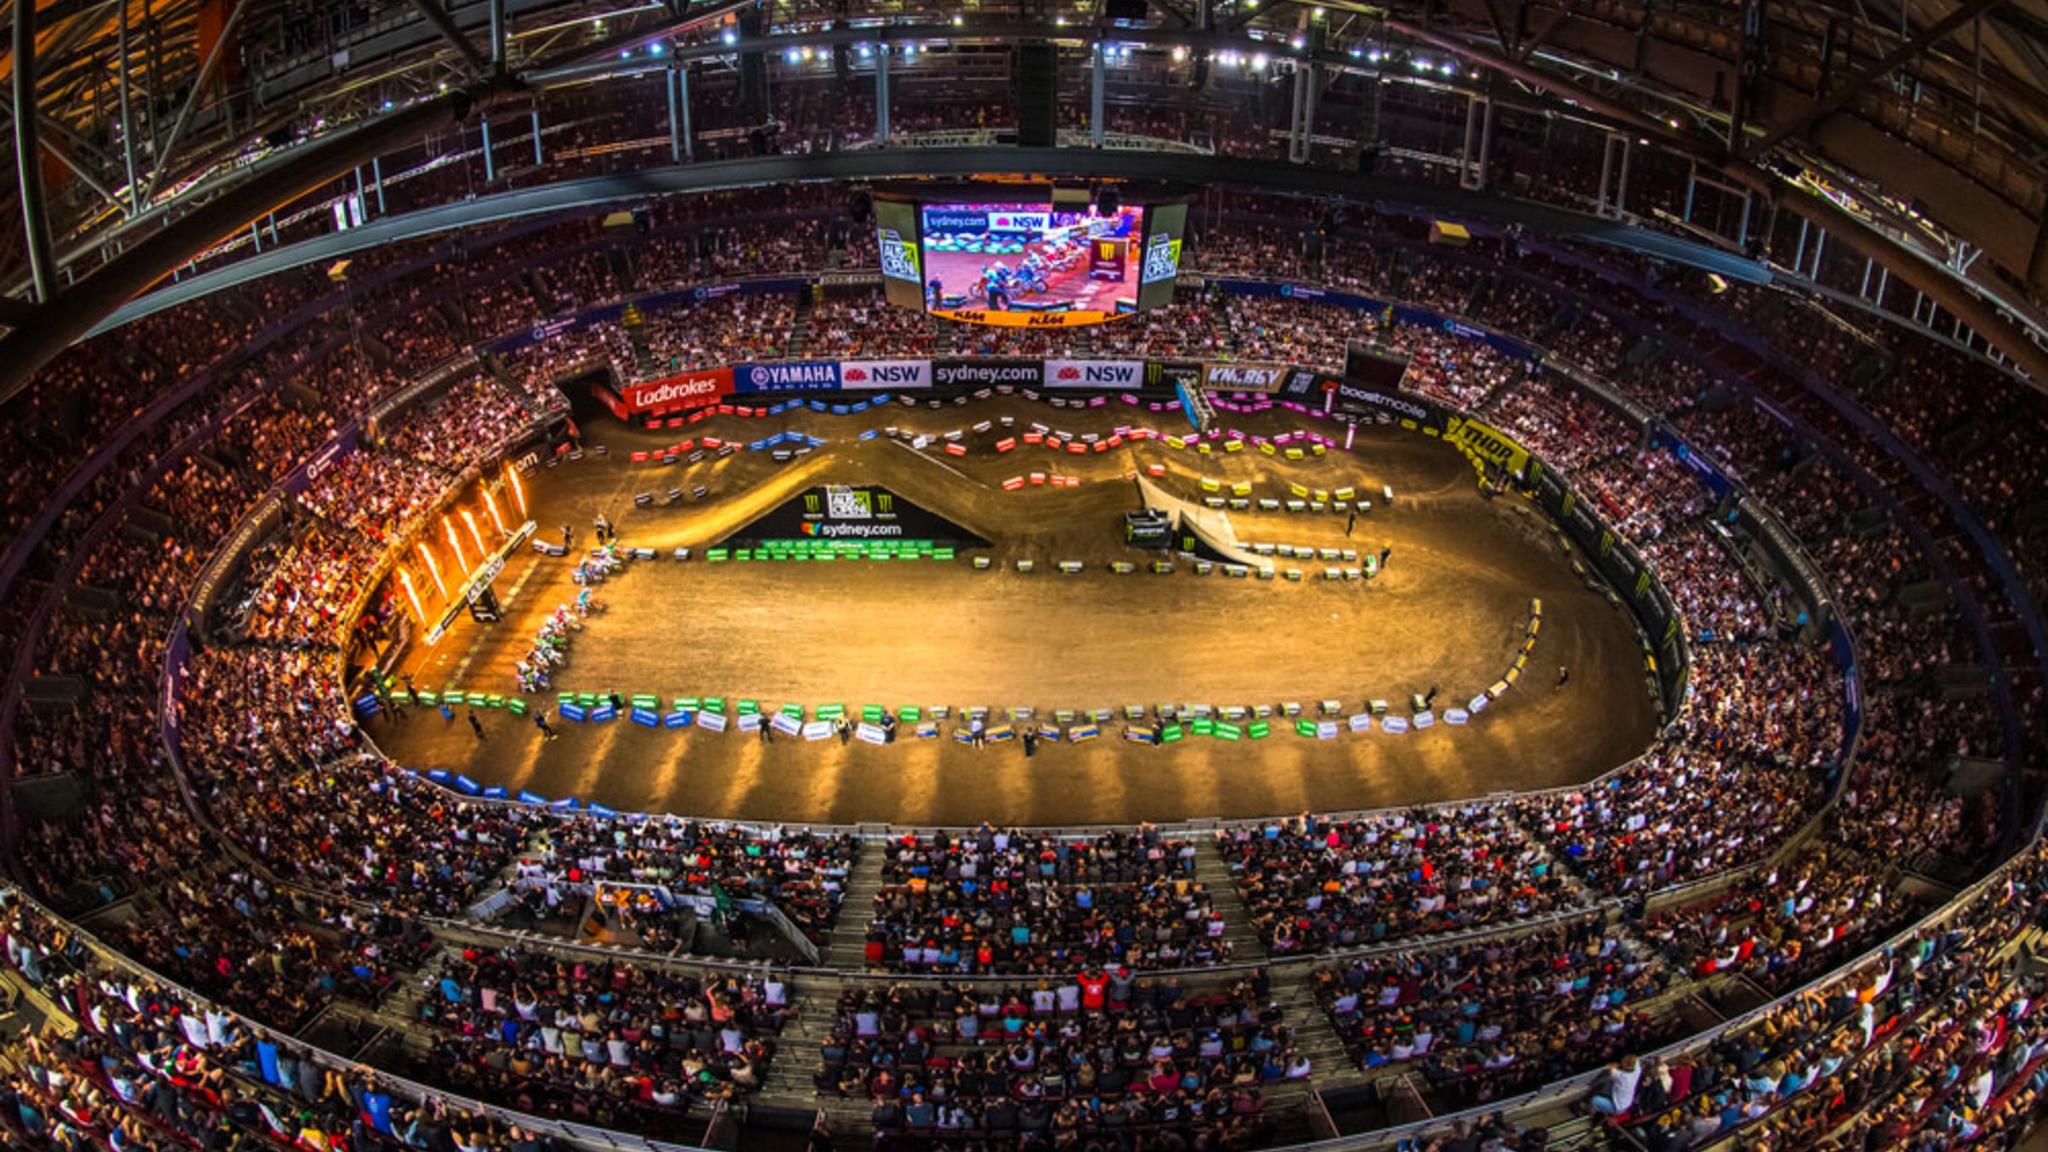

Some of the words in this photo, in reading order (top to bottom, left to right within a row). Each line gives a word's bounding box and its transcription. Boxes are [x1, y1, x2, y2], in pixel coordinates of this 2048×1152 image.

[1013, 217, 1044, 228] NSW
[1028, 314, 1065, 325] KTM
[769, 365, 836, 383] YAMAHA
[872, 366, 920, 383] NSW
[936, 365, 1038, 384] sydney.com
[1085, 366, 1134, 383] NSW
[635, 377, 717, 407] Ladbrokes
[1464, 425, 1514, 459] THOR
[822, 523, 902, 538] sydney.com
